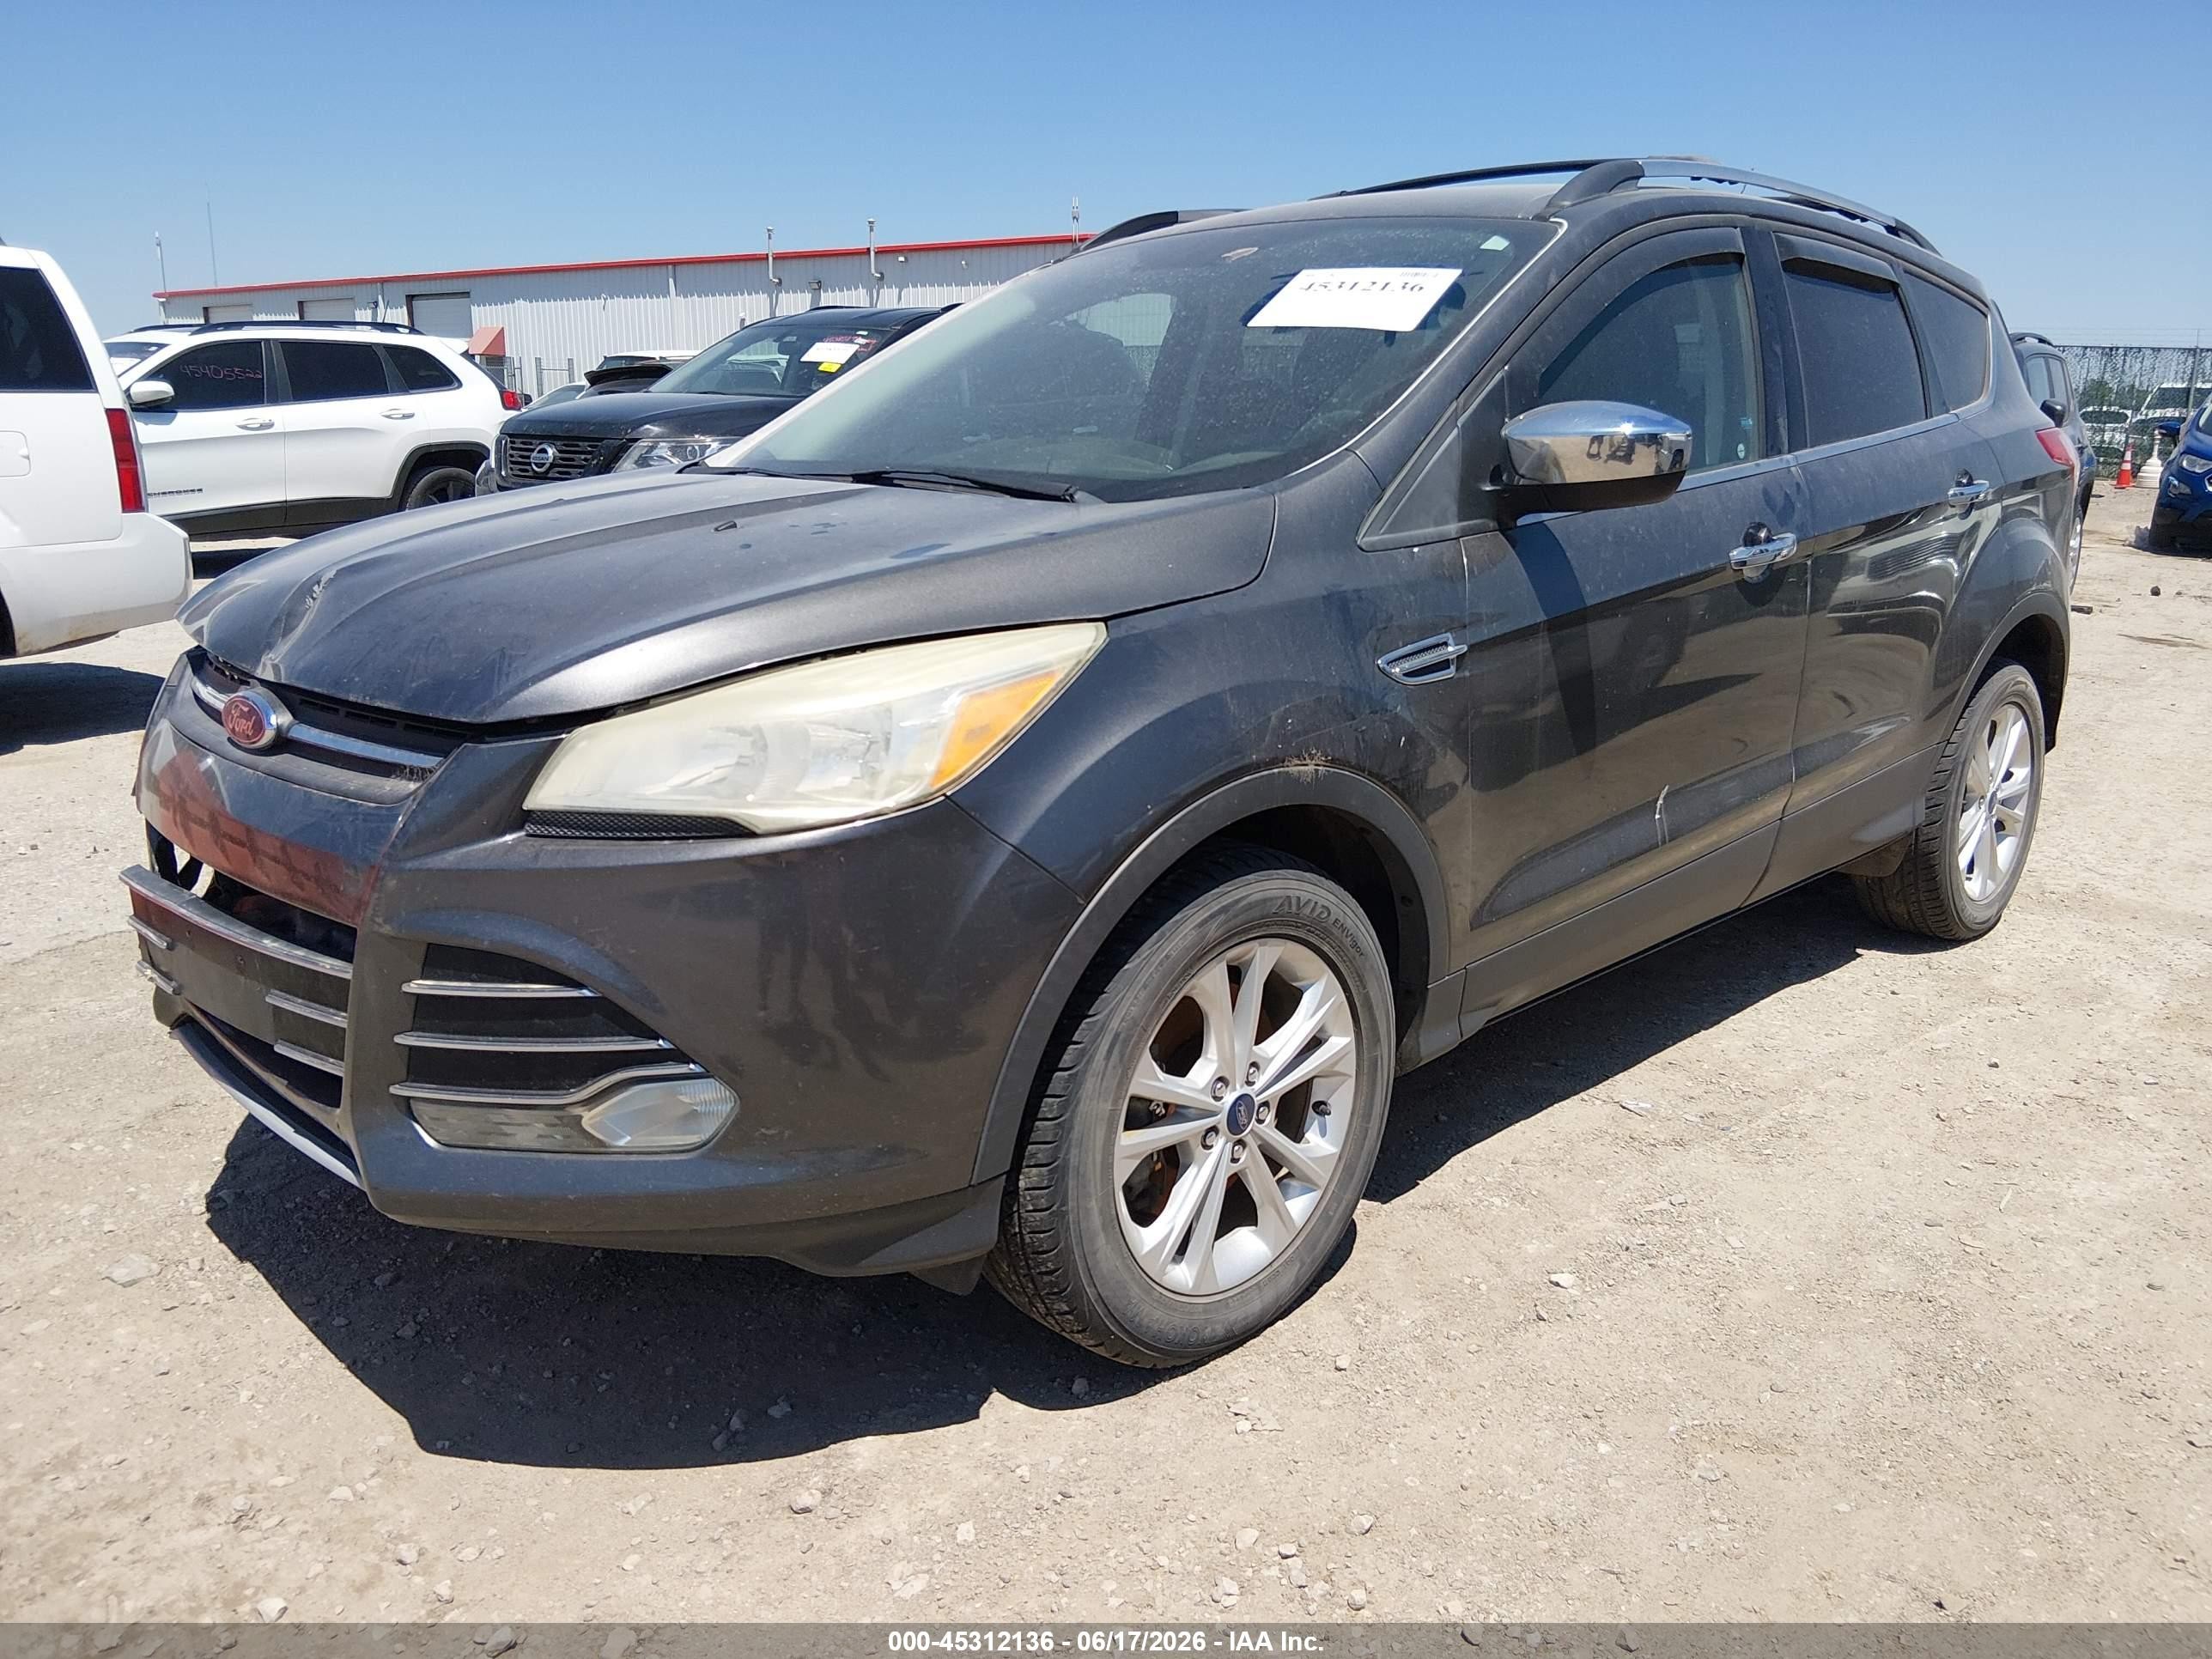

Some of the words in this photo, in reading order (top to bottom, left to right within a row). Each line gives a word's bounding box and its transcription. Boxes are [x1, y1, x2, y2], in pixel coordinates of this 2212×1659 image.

[179, 364, 262, 380] 45405522
[228, 702, 257, 736] Ford
[1272, 895, 1332, 922] AVID
